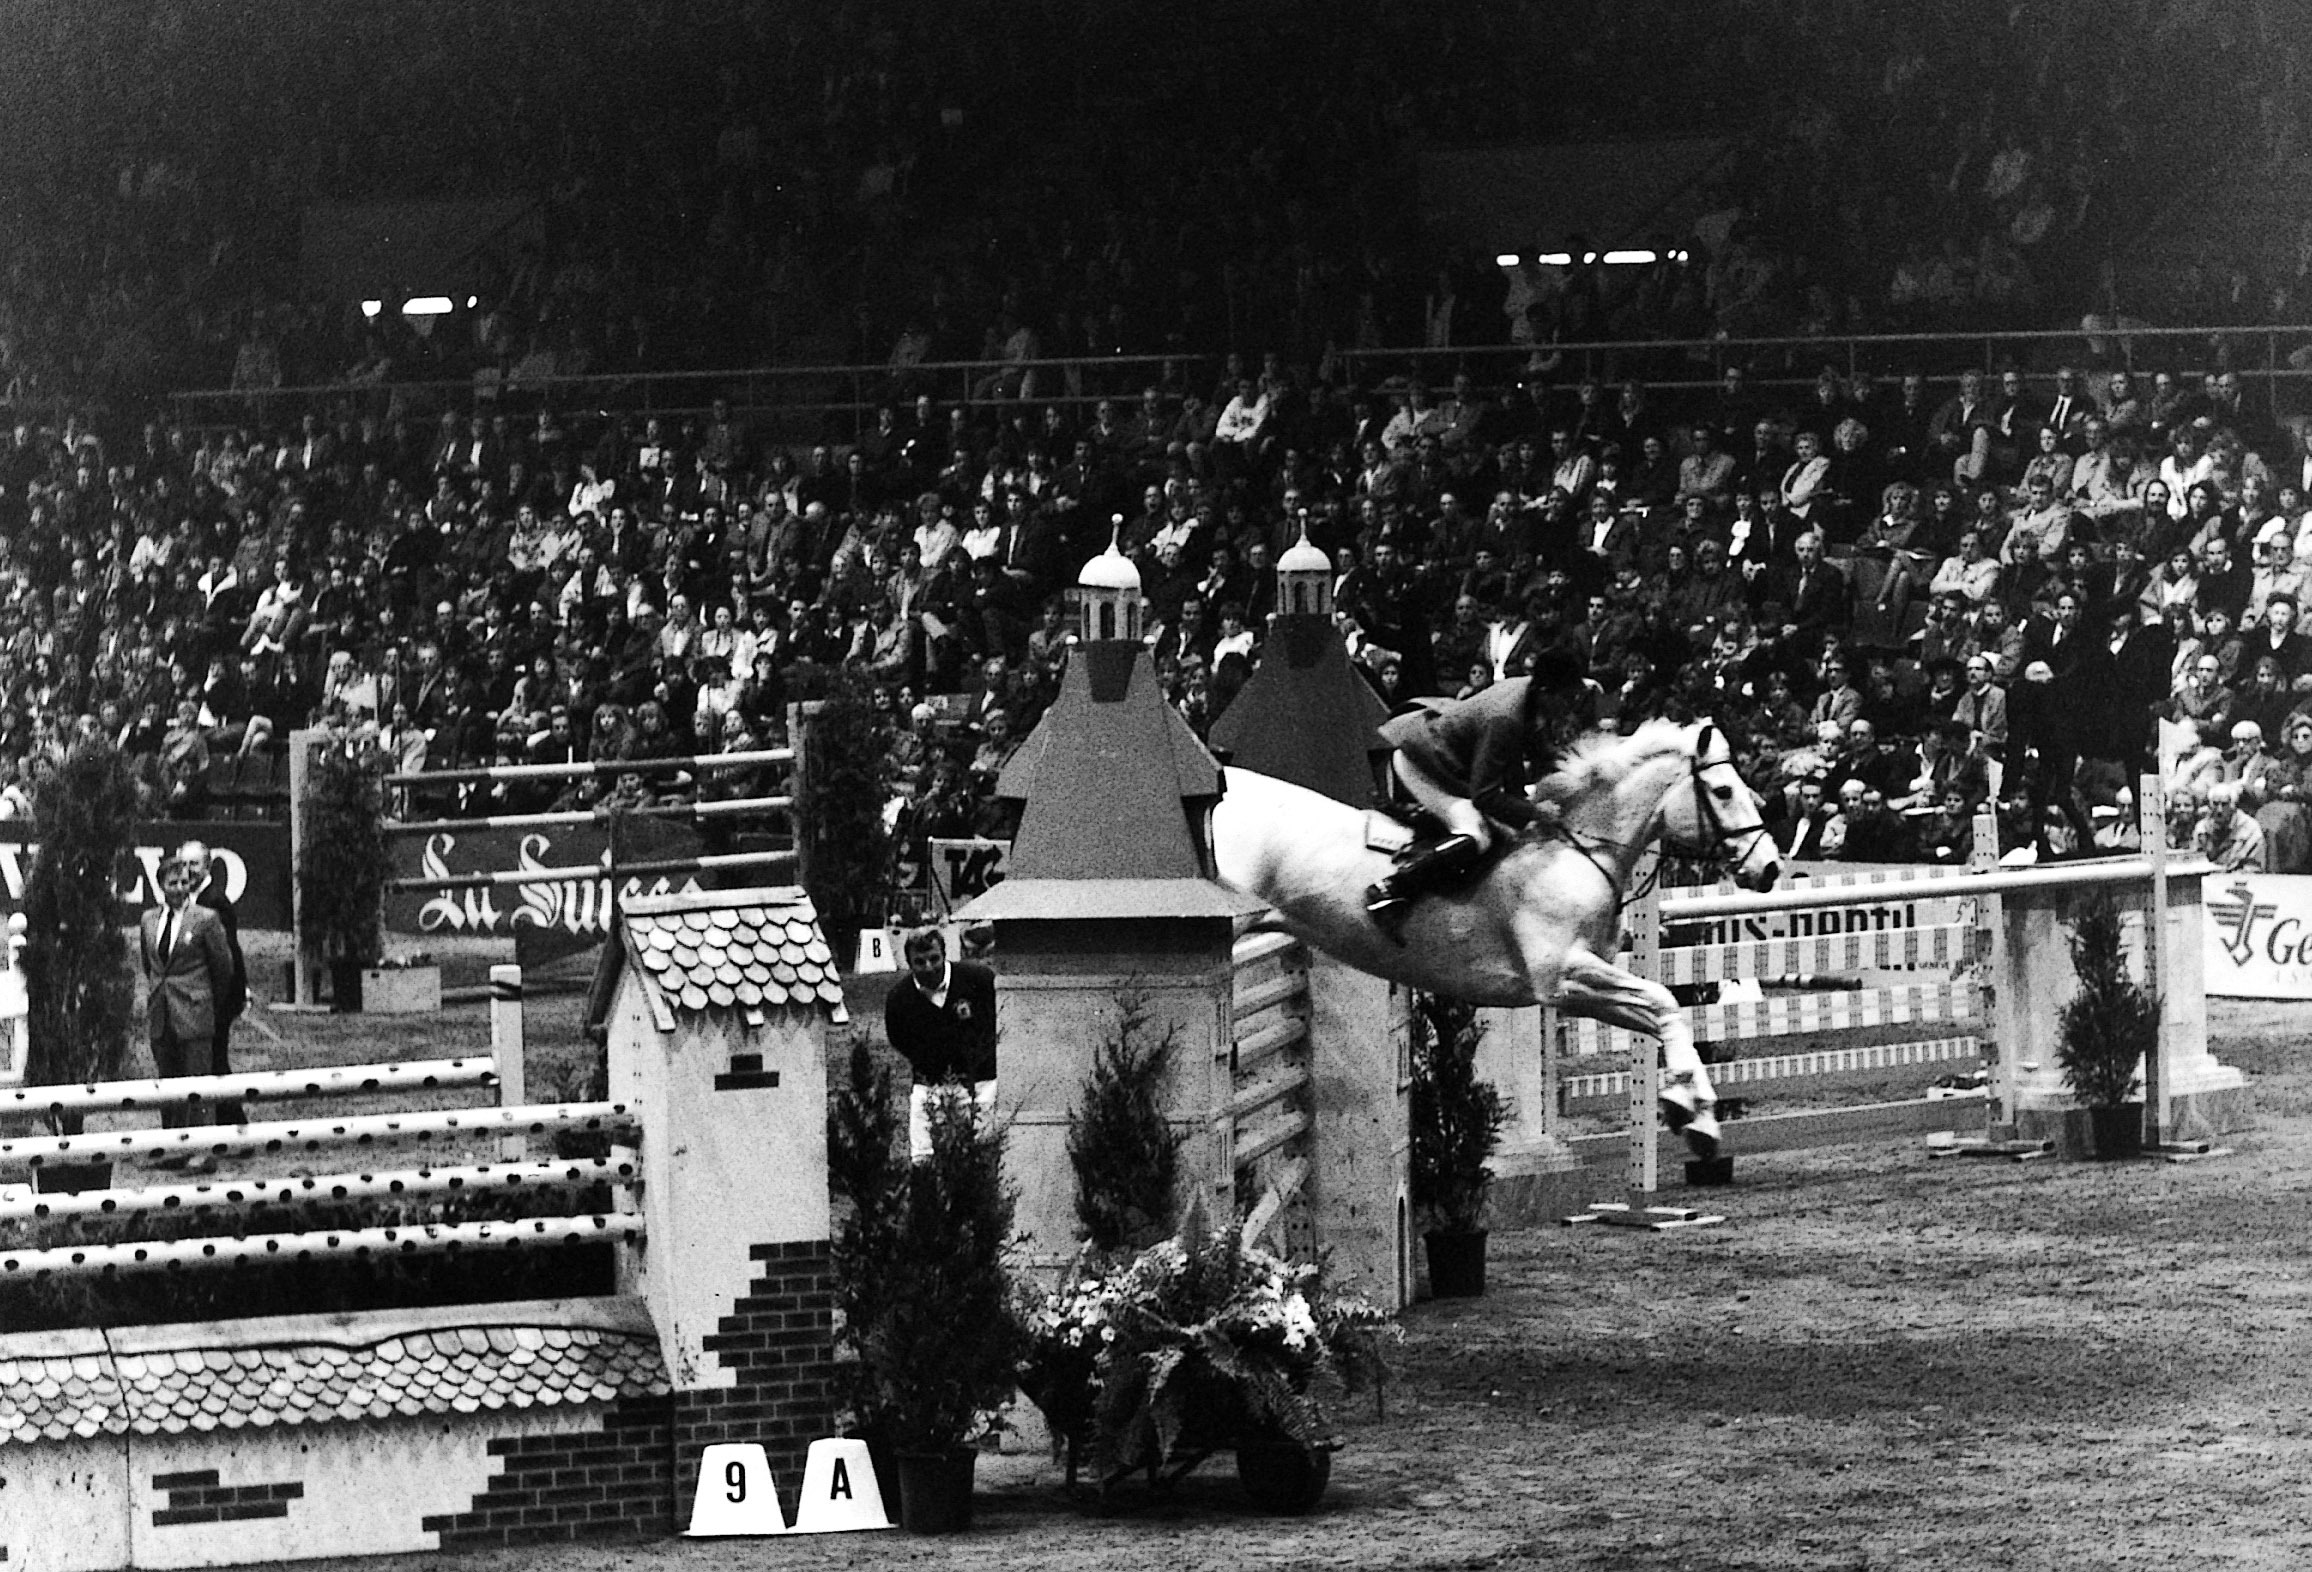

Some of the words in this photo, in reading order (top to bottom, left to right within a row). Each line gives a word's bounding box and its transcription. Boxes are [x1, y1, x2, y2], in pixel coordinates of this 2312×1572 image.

[872, 938, 881, 958] B
[725, 1461, 746, 1503] 9
[830, 1457, 853, 1500] A
